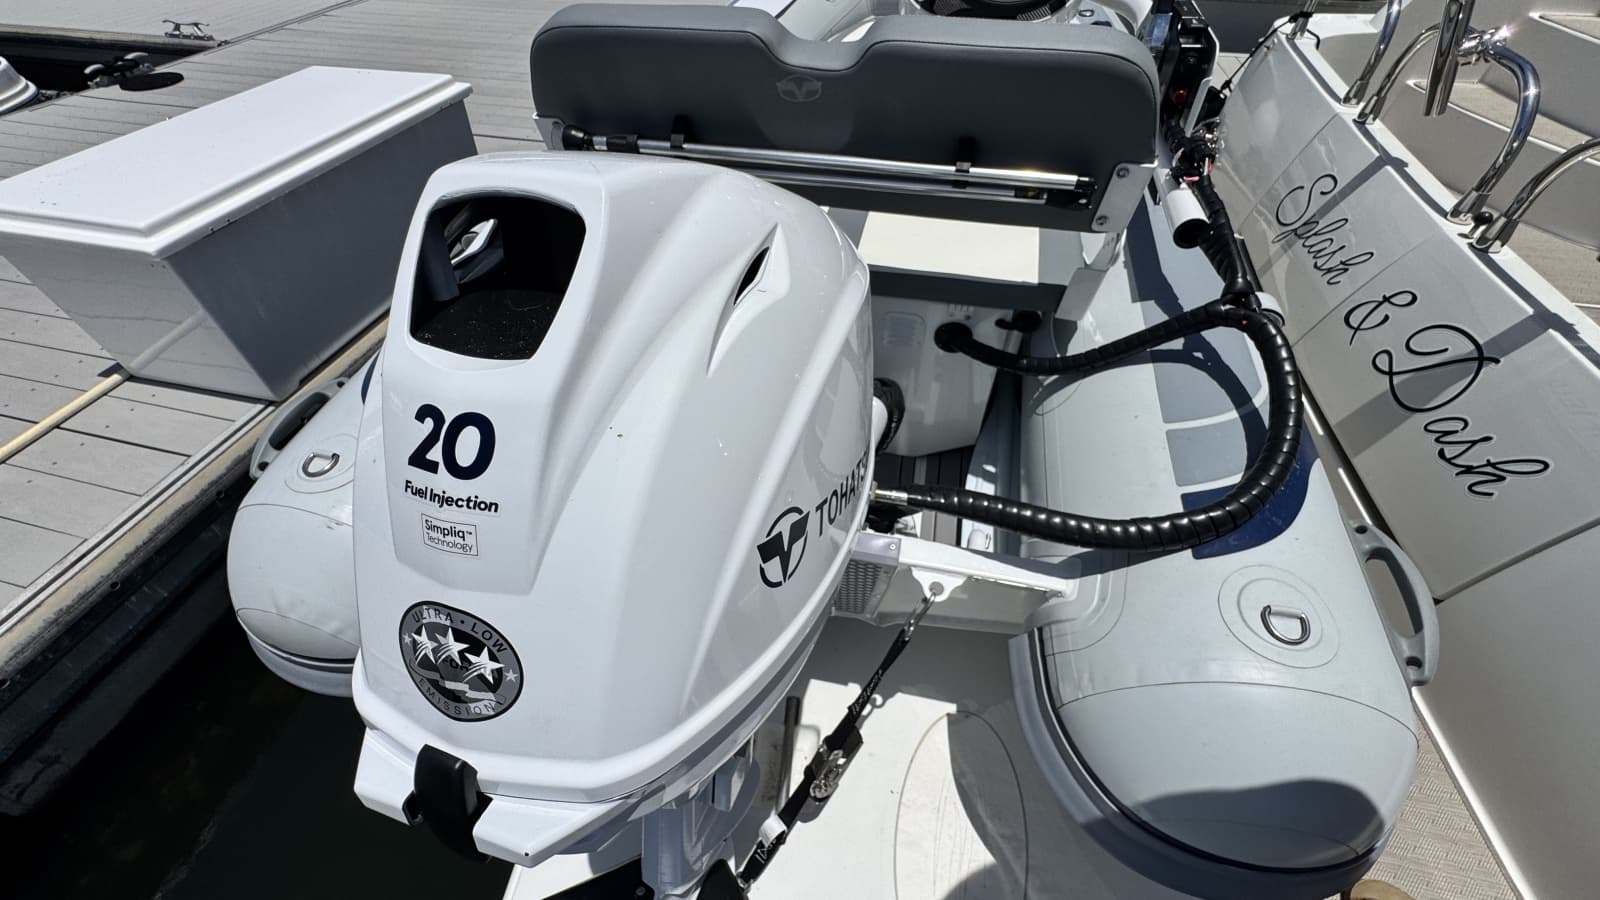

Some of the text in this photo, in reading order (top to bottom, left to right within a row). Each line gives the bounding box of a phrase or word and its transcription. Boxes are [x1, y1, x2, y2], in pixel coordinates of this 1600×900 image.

[1272, 173, 1550, 497] Splash & Dash
[407, 403, 496, 481] 20
[404, 479, 499, 513] Fuel Injection
[425, 532, 473, 553] Technology
[411, 606, 508, 653] ULTRA LOW
[418, 677, 496, 717] EMISSION
